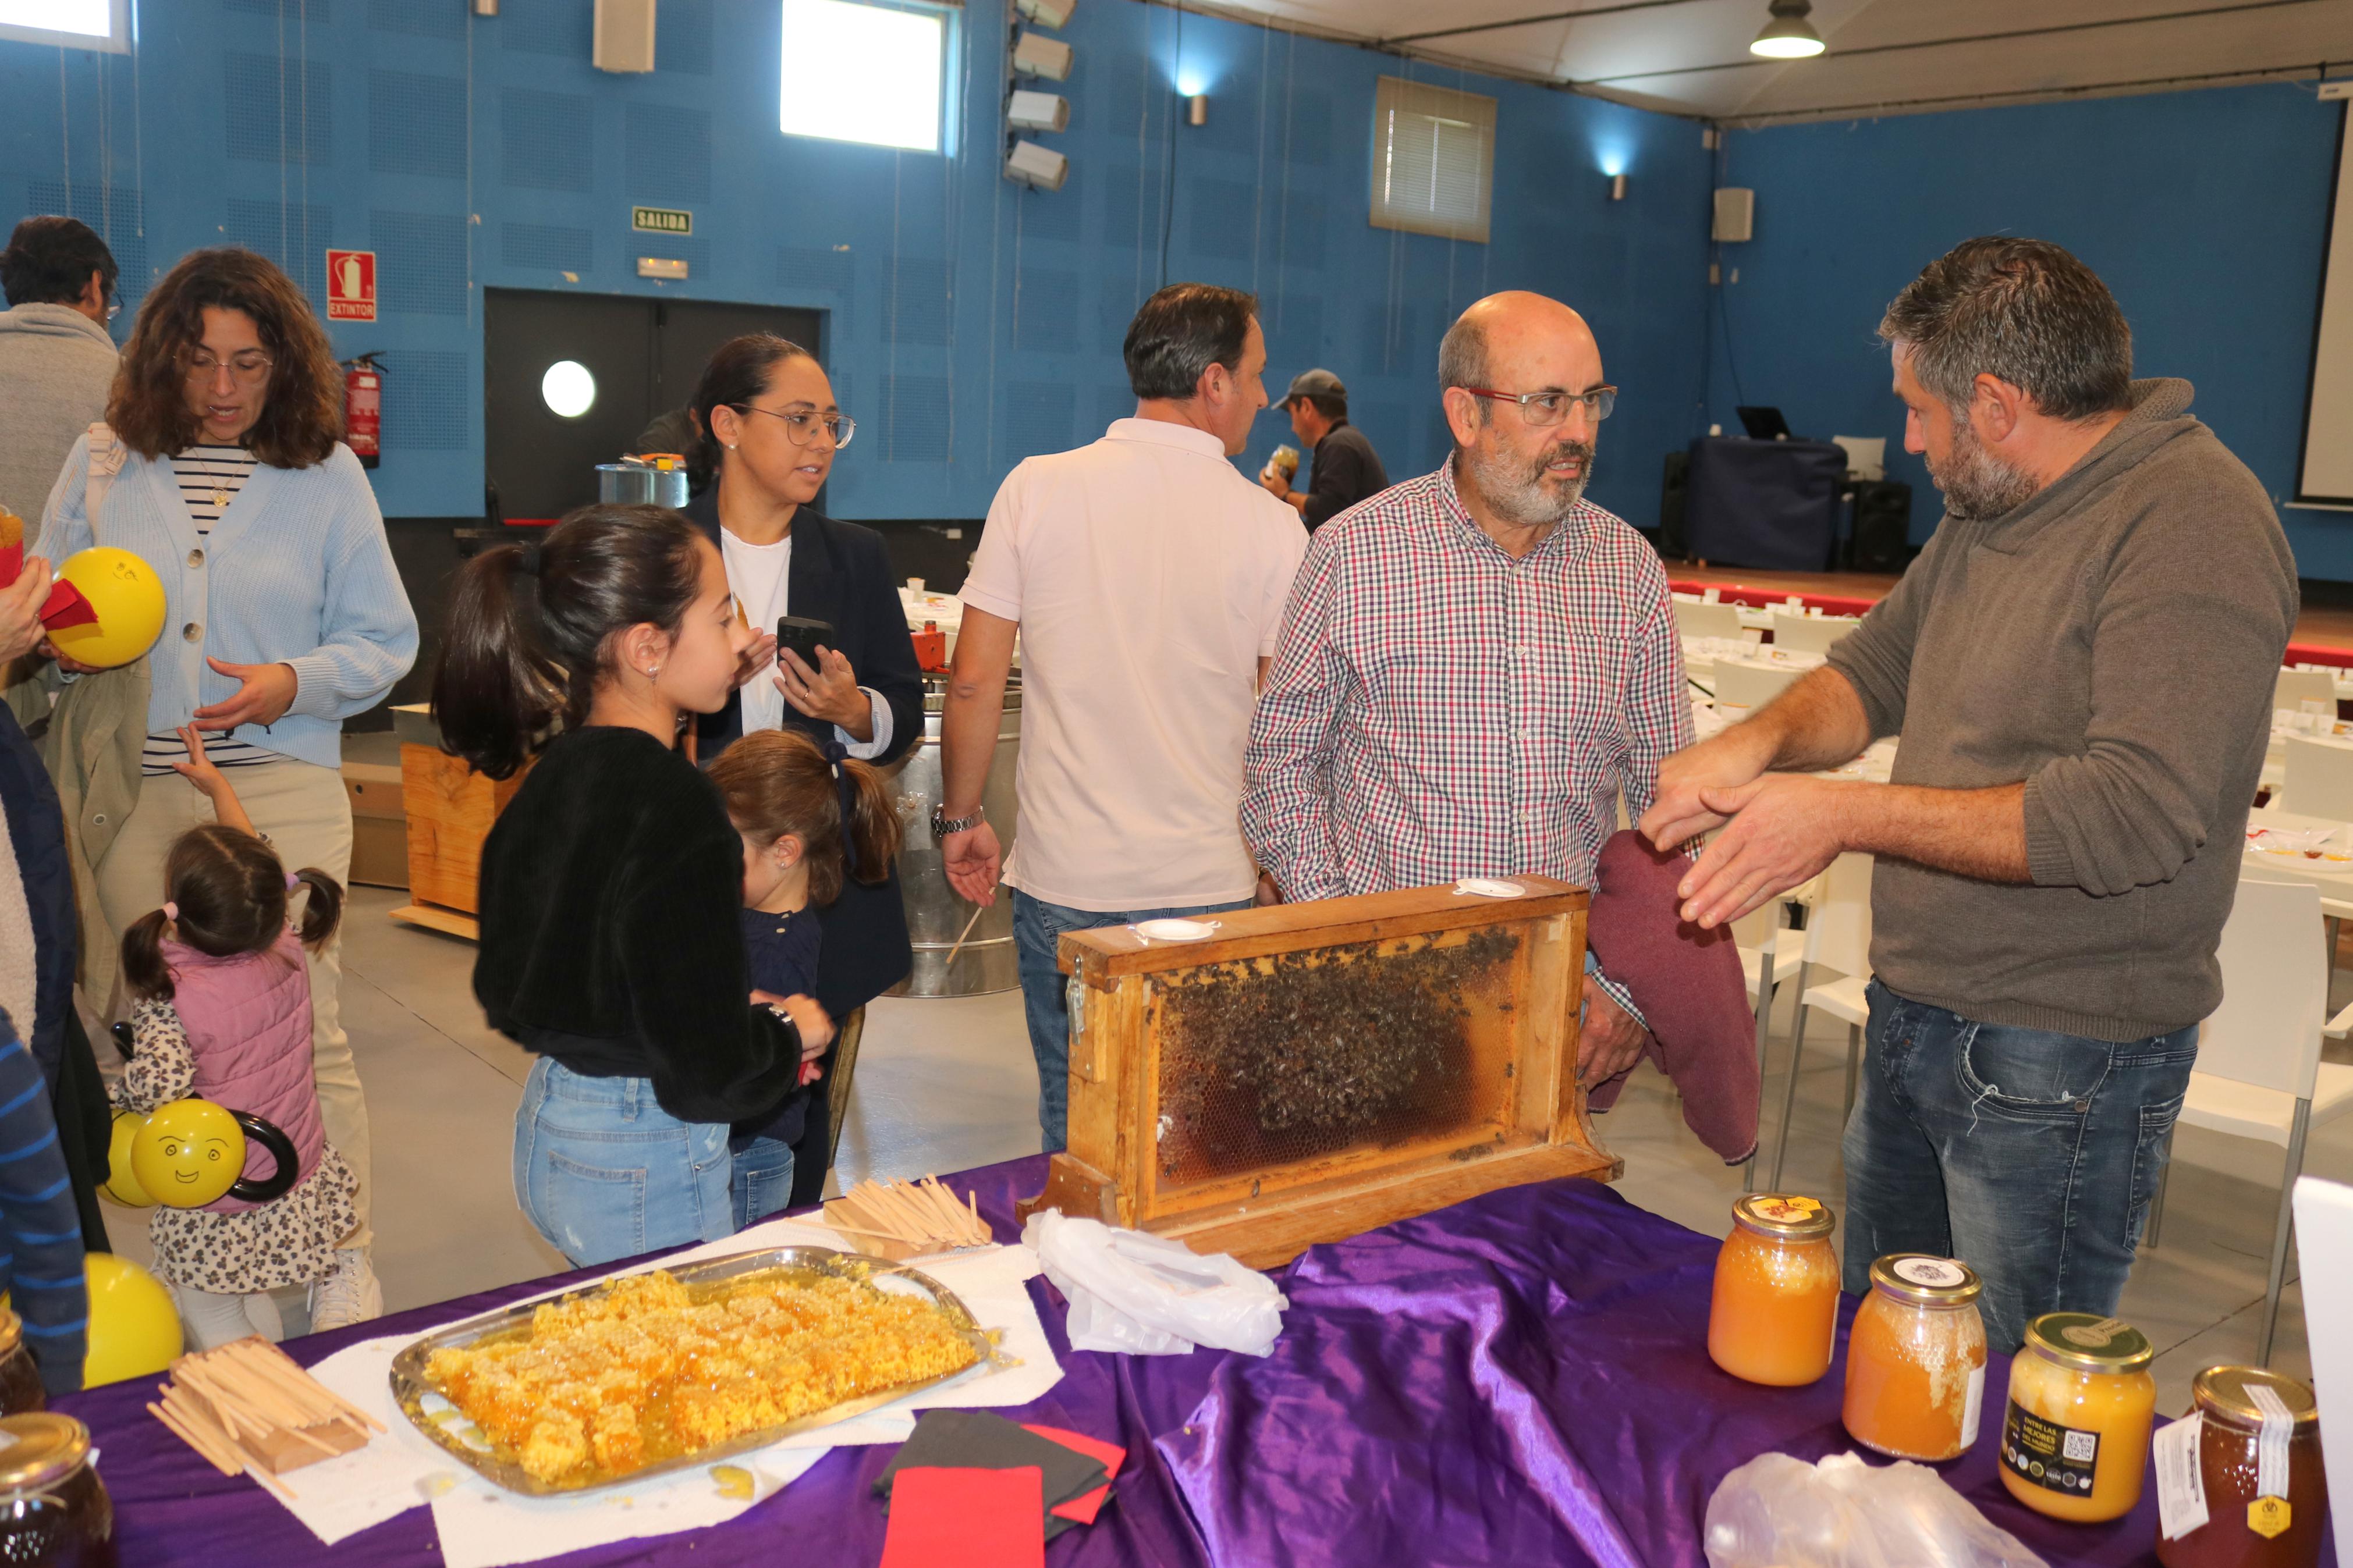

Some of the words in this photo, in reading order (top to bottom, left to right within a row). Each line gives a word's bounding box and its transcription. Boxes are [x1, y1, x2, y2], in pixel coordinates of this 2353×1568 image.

[638, 212, 686, 230] SALIDA
[330, 302, 373, 316] EXTINTOR
[2023, 1424, 2056, 1444] MEJORES
[2025, 1417, 2043, 1431] ENTRE
[2043, 1425, 2057, 1435] LAS
[2022, 1433, 2031, 1442] DEL
[2031, 1437, 2055, 1451] MUNDO
